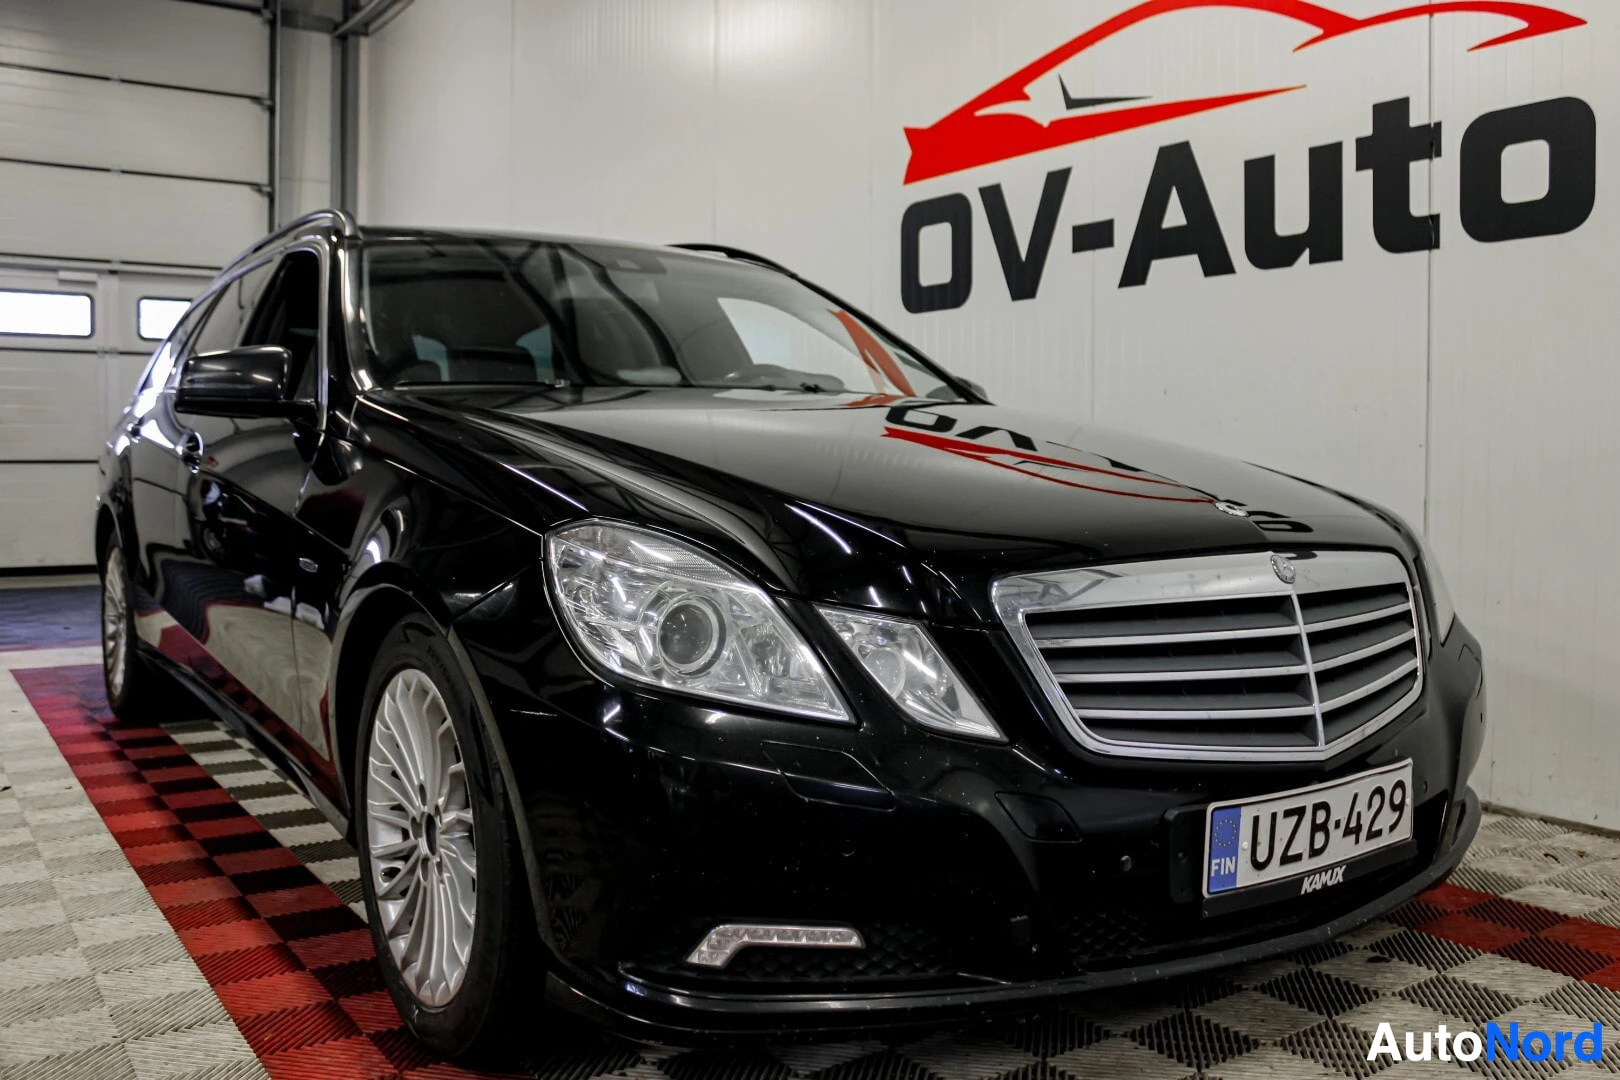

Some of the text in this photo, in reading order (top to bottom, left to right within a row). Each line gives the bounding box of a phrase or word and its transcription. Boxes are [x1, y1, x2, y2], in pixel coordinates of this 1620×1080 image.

[900, 96, 1597, 315] OV-Auto
[1250, 779, 1407, 871] UZB-429
[1210, 856, 1236, 877] FIN
[1300, 865, 1347, 895] KAMUX
